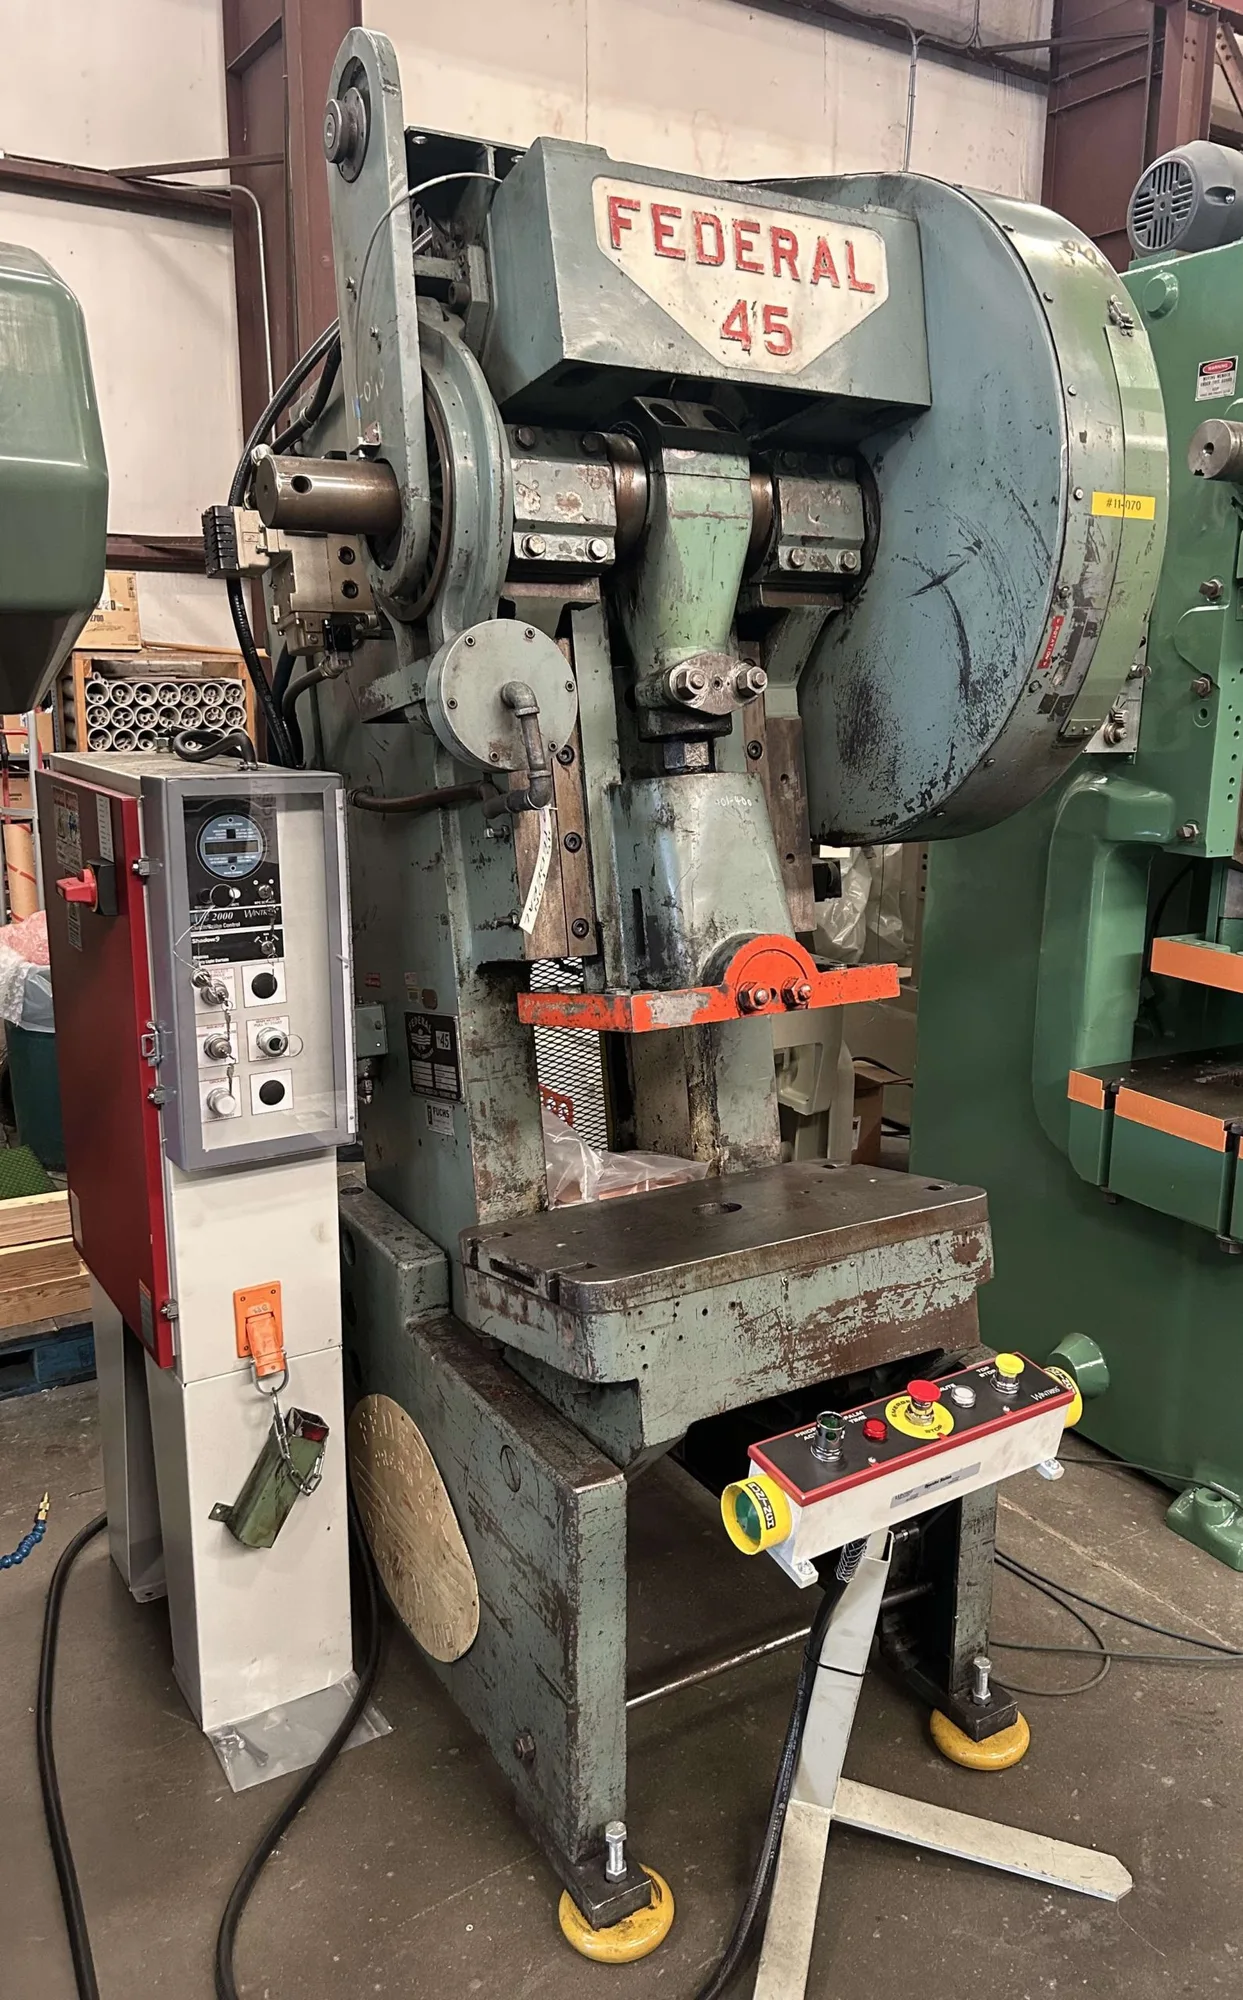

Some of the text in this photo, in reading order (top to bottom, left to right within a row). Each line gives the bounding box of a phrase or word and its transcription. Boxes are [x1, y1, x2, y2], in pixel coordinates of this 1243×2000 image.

[606, 194, 876, 294] FEDERAL
[720, 298, 793, 356] 45
[1106, 497, 1142, 511] #11-070
[211, 911, 234, 921] 2000
[243, 907, 276, 919] WINTR
[407, 1015, 432, 1034] FEDERAL
[440, 1034, 450, 1048] 45
[432, 1106, 450, 1118] FUCHS
[979, 1369, 996, 1378] STOP
[940, 1383, 957, 1391] UTE
[891, 1399, 911, 1418] EMERGE
[843, 1410, 864, 1420] PALM
[848, 1414, 867, 1424] TIME
[924, 1424, 943, 1434] STOP
[803, 1432, 816, 1441] AC
